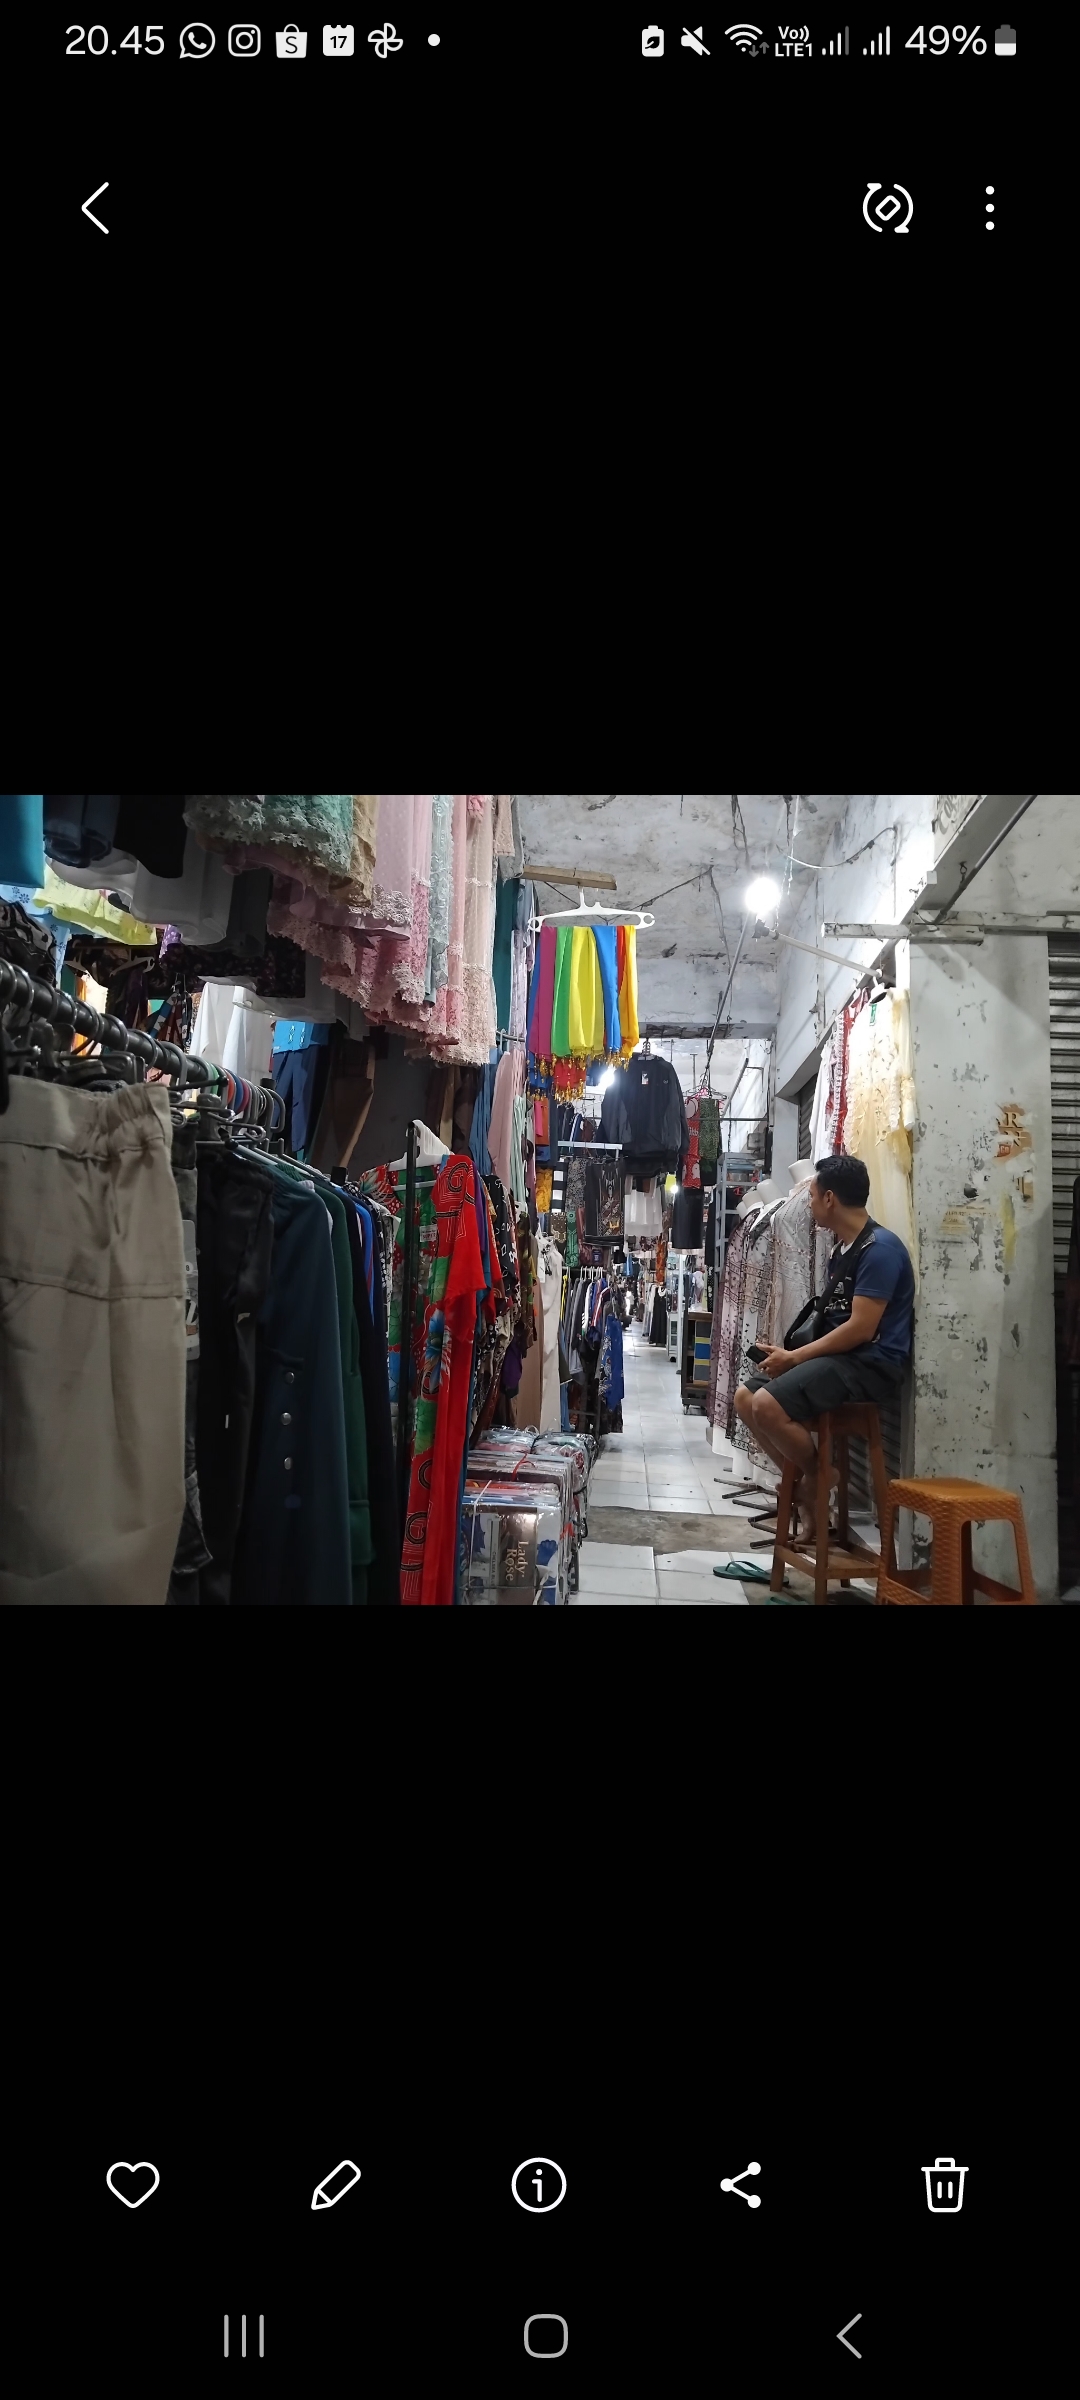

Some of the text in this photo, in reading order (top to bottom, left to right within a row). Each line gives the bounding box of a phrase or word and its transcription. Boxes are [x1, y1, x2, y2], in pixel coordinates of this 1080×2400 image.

[66, 25, 165, 56] 20.45
[330, 36, 347, 49] 17
[775, 43, 812, 57] LTE1
[904, 25, 988, 56] 49%
[504, 1548, 517, 1582] Rose
[515, 1541, 529, 1574] Lady
